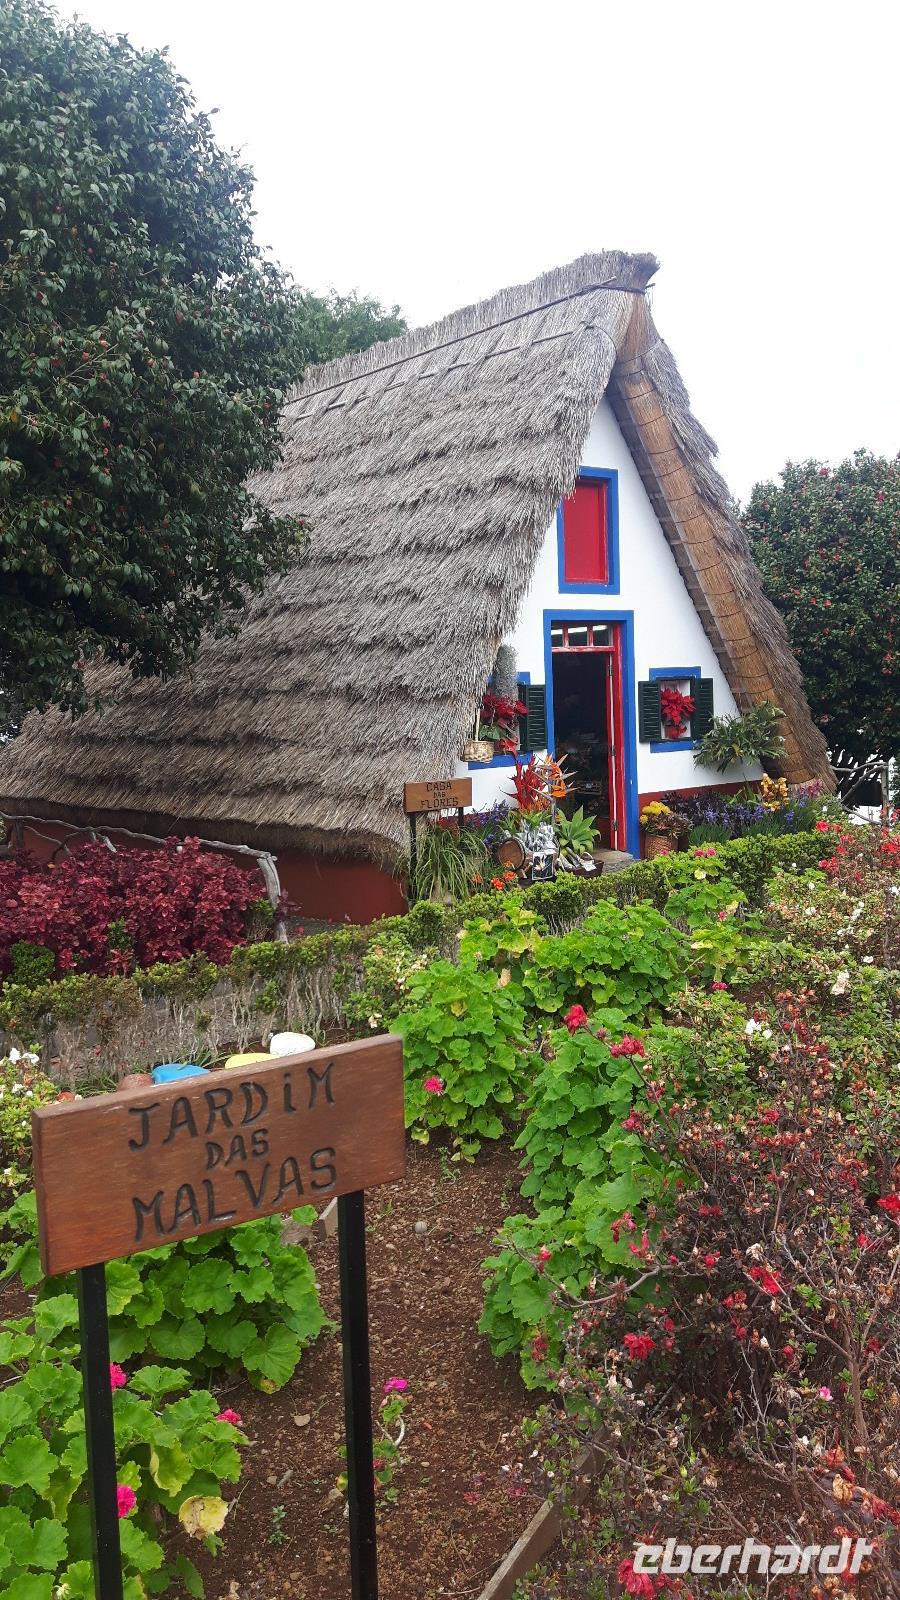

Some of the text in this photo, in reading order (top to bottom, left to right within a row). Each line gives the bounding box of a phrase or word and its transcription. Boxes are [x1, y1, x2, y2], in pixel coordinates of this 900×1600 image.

[426, 781, 452, 792] CASA
[420, 797, 459, 809] FLORES
[205, 1128, 270, 1171] DAS
[131, 1147, 338, 1243] MALVAS
